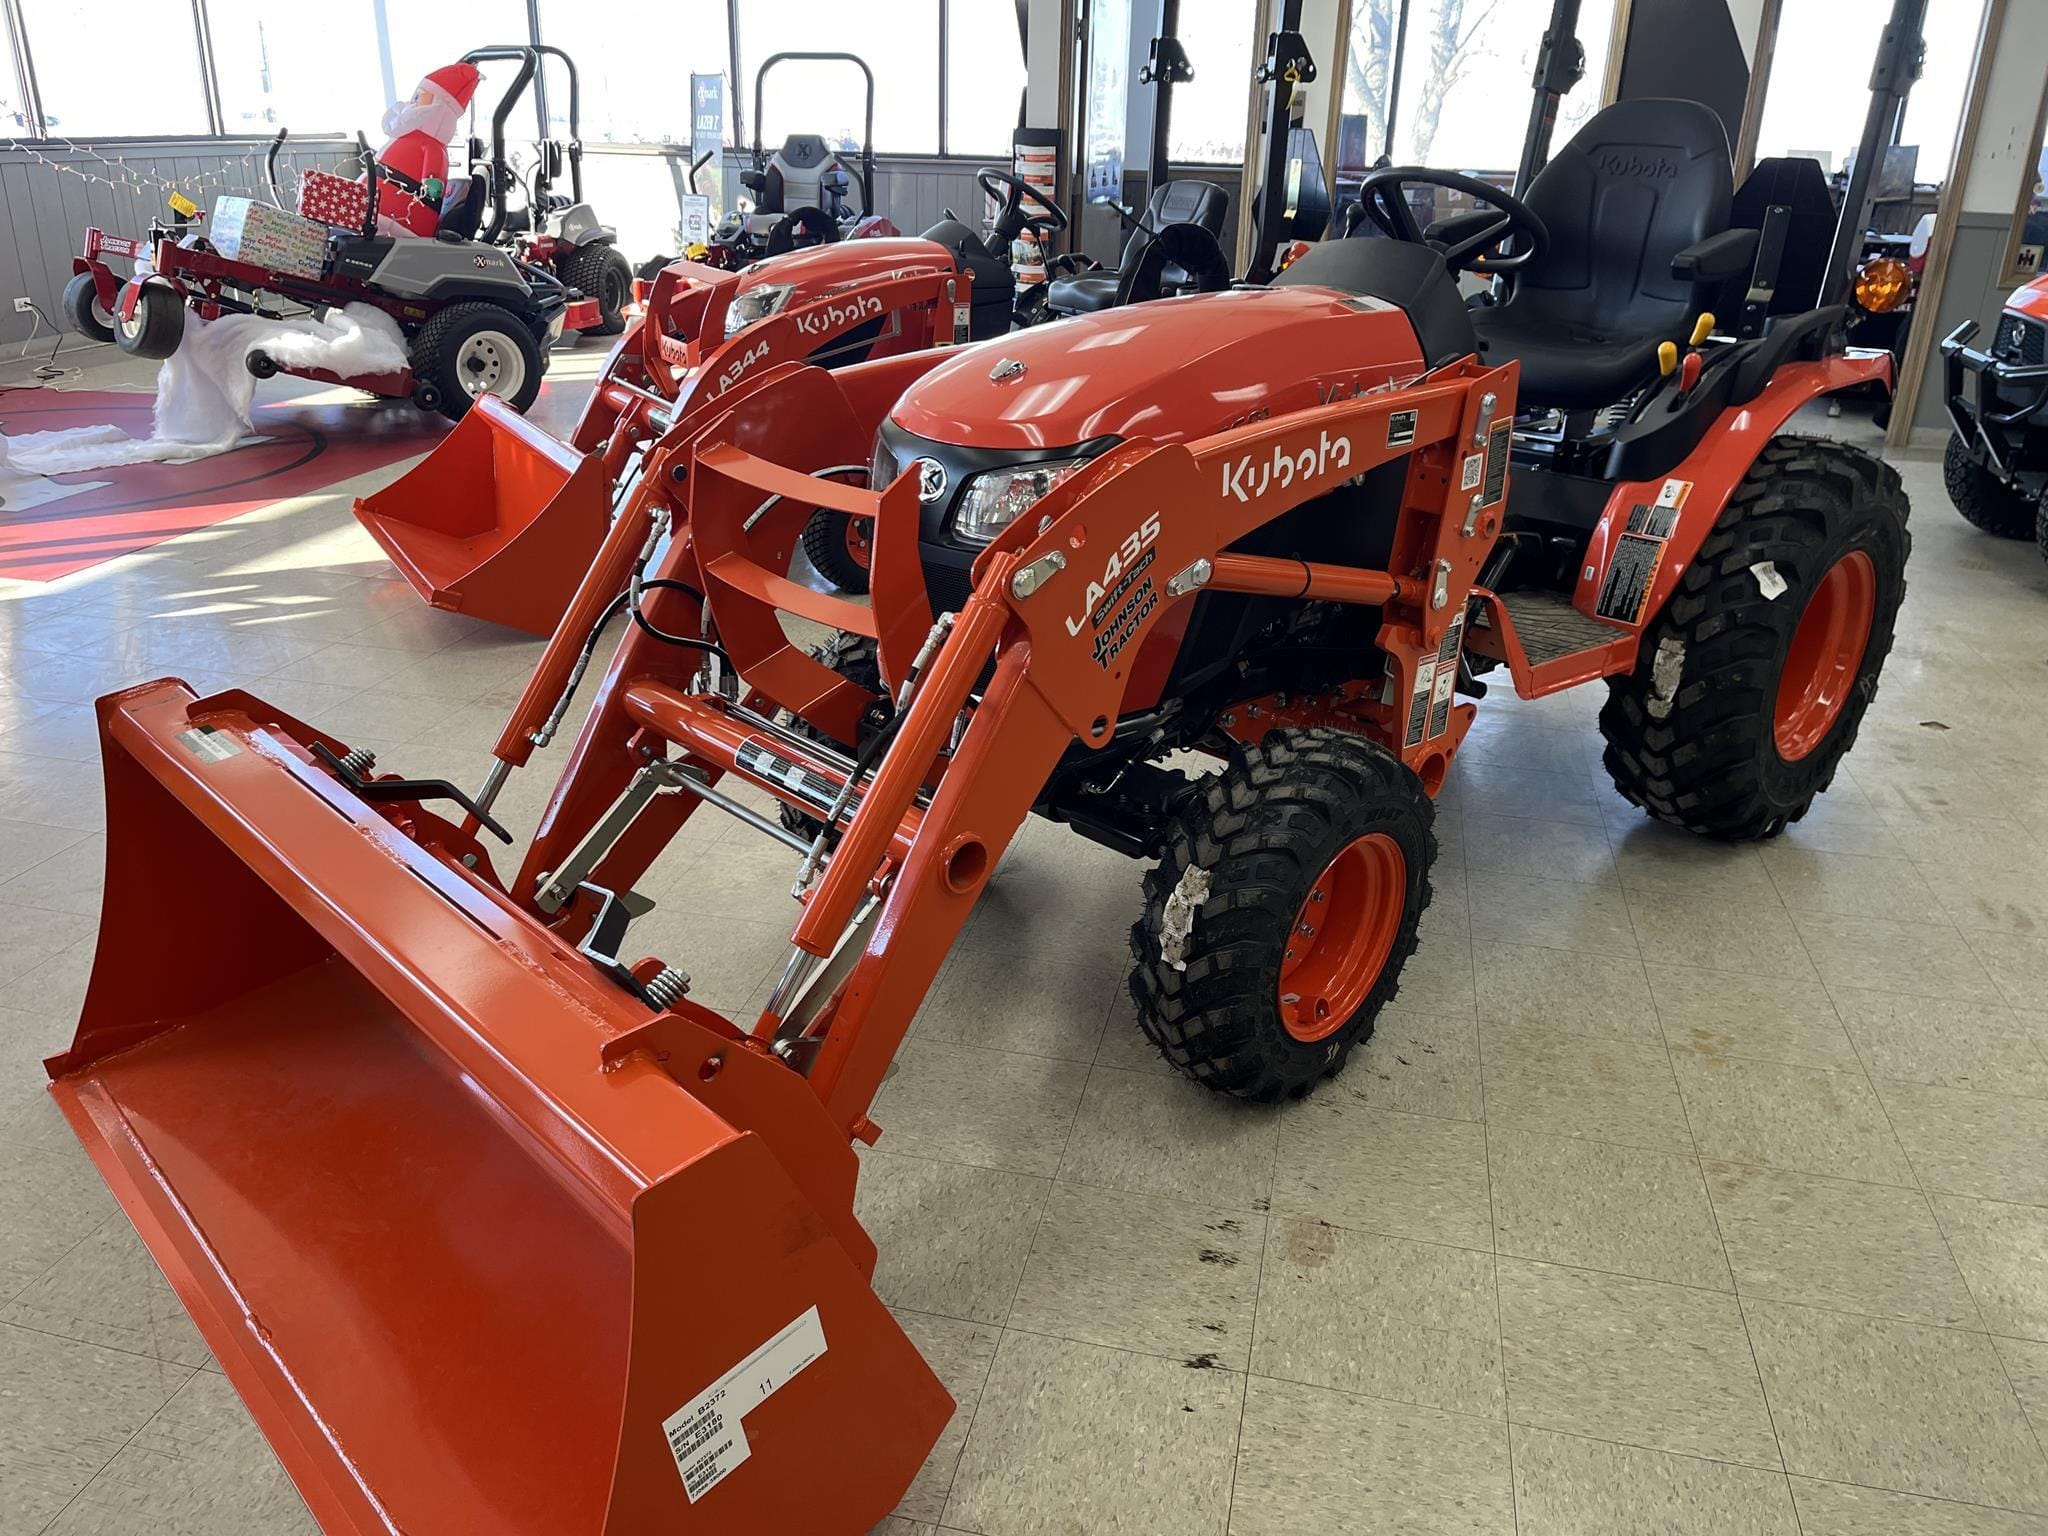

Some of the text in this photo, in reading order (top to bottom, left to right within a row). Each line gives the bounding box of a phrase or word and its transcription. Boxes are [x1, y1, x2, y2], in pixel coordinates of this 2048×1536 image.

[1600, 154, 1678, 178] Kubota
[257, 238, 288, 253] Christmas
[473, 255, 505, 268] eXmark
[795, 295, 883, 335] Kubota
[662, 340, 687, 365] Kubota
[1222, 430, 1351, 503] Kubota
[1065, 510, 1161, 637] LA435
[1091, 575, 1154, 661] JOHNSON
[1096, 591, 1160, 671] TRACTOR
[759, 1377, 773, 1395] 11
[668, 1389, 727, 1438] Model B2372
[674, 1413, 723, 1455] S/N E3180
